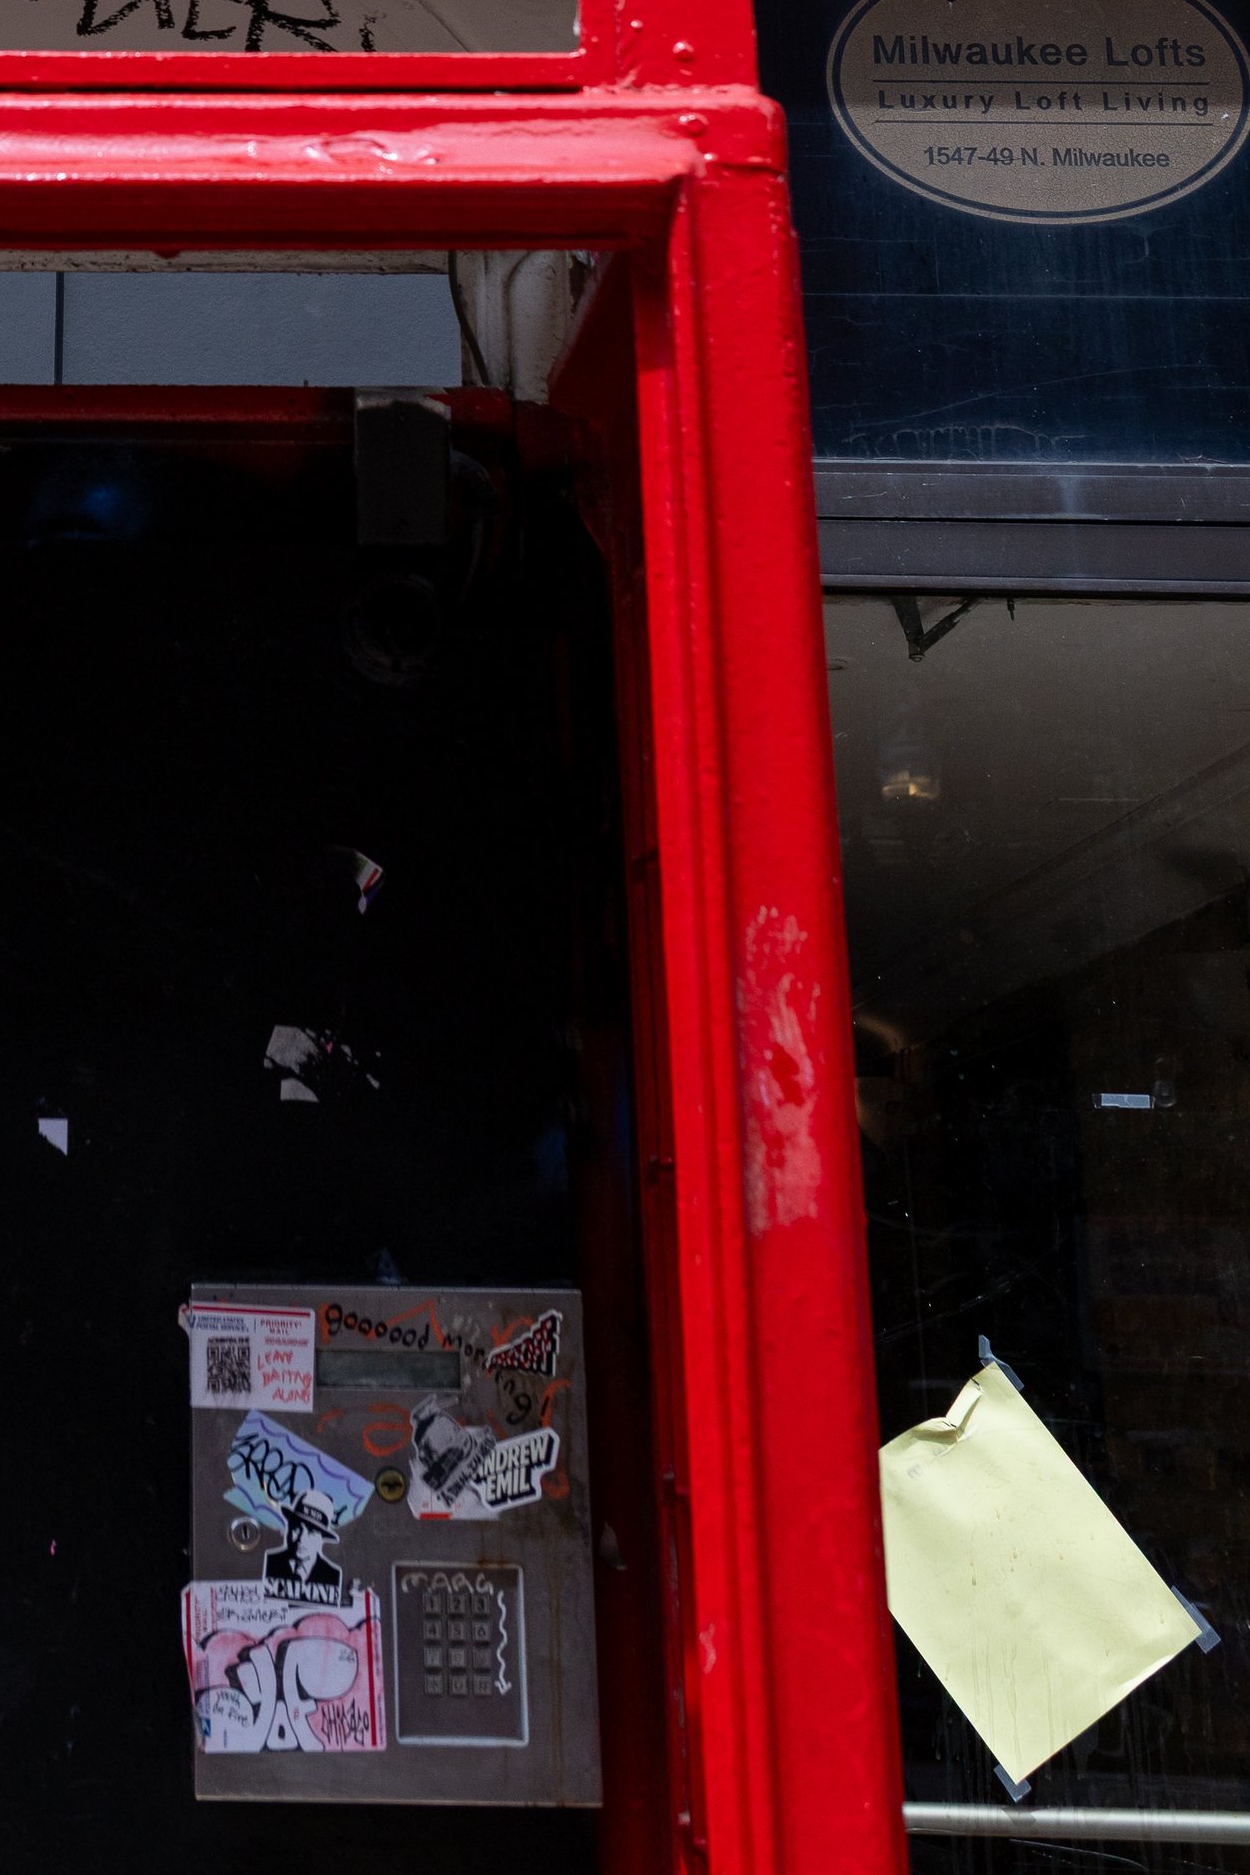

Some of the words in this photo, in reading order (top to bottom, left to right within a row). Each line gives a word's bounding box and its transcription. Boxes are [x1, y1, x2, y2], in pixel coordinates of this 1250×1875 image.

[873, 35, 1088, 67] Milwaukee
[1105, 36, 1207, 68] Lofts
[877, 89, 995, 114] Luxury
[1014, 90, 1082, 111] Loft
[1103, 92, 1210, 117] Living
[923, 145, 1014, 167] 1547-49
[1021, 147, 1045, 167] N.
[1052, 147, 1171, 168] Milwaukee
[485, 1467, 534, 1506] EMIL
